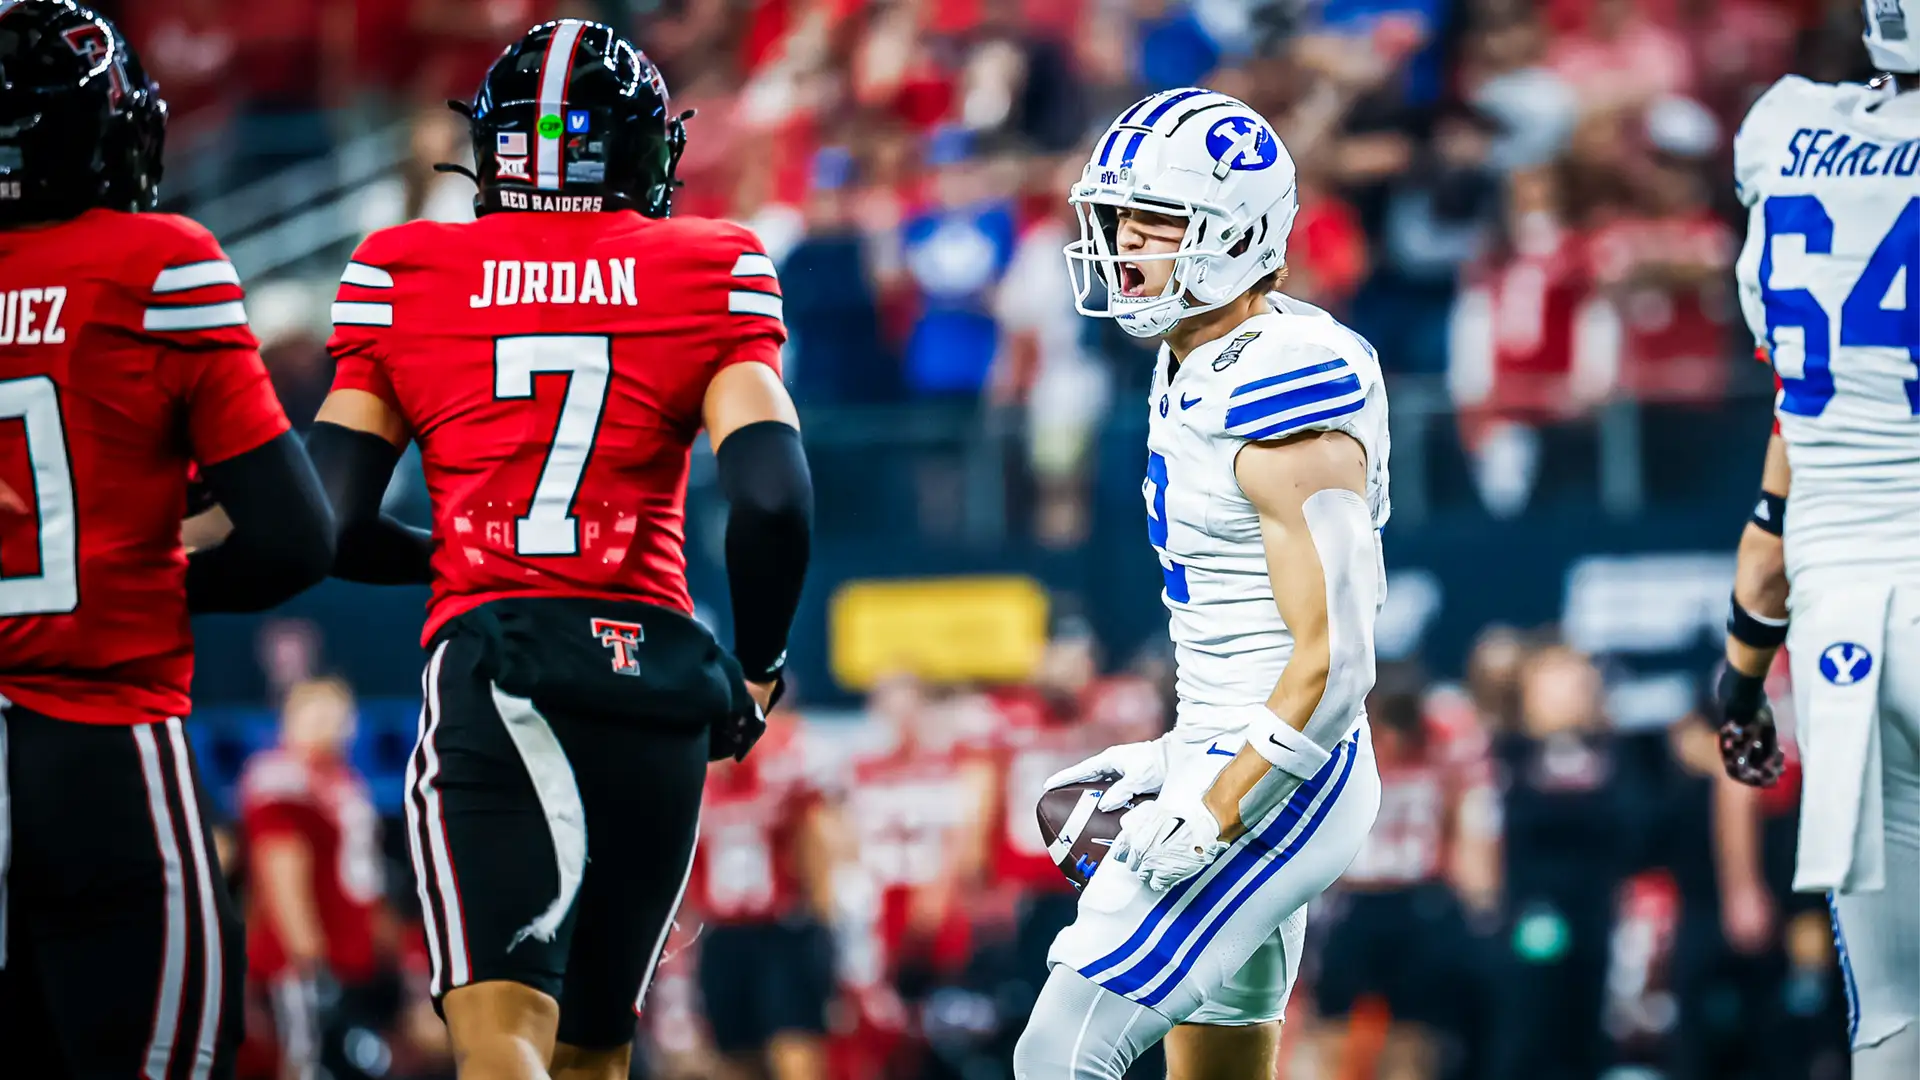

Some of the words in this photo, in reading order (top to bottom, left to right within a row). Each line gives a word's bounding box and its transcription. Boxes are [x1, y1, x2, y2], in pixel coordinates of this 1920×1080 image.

[500, 190, 528, 209] RED
[531, 195, 603, 213] RAIDERS
[1100, 171, 1119, 185] BYU
[469, 257, 638, 308] JORDAN
[1759, 195, 1920, 418] 64
[0, 286, 68, 345] UEZ
[493, 333, 614, 557] 7
[1825, 643, 1869, 686] Y
